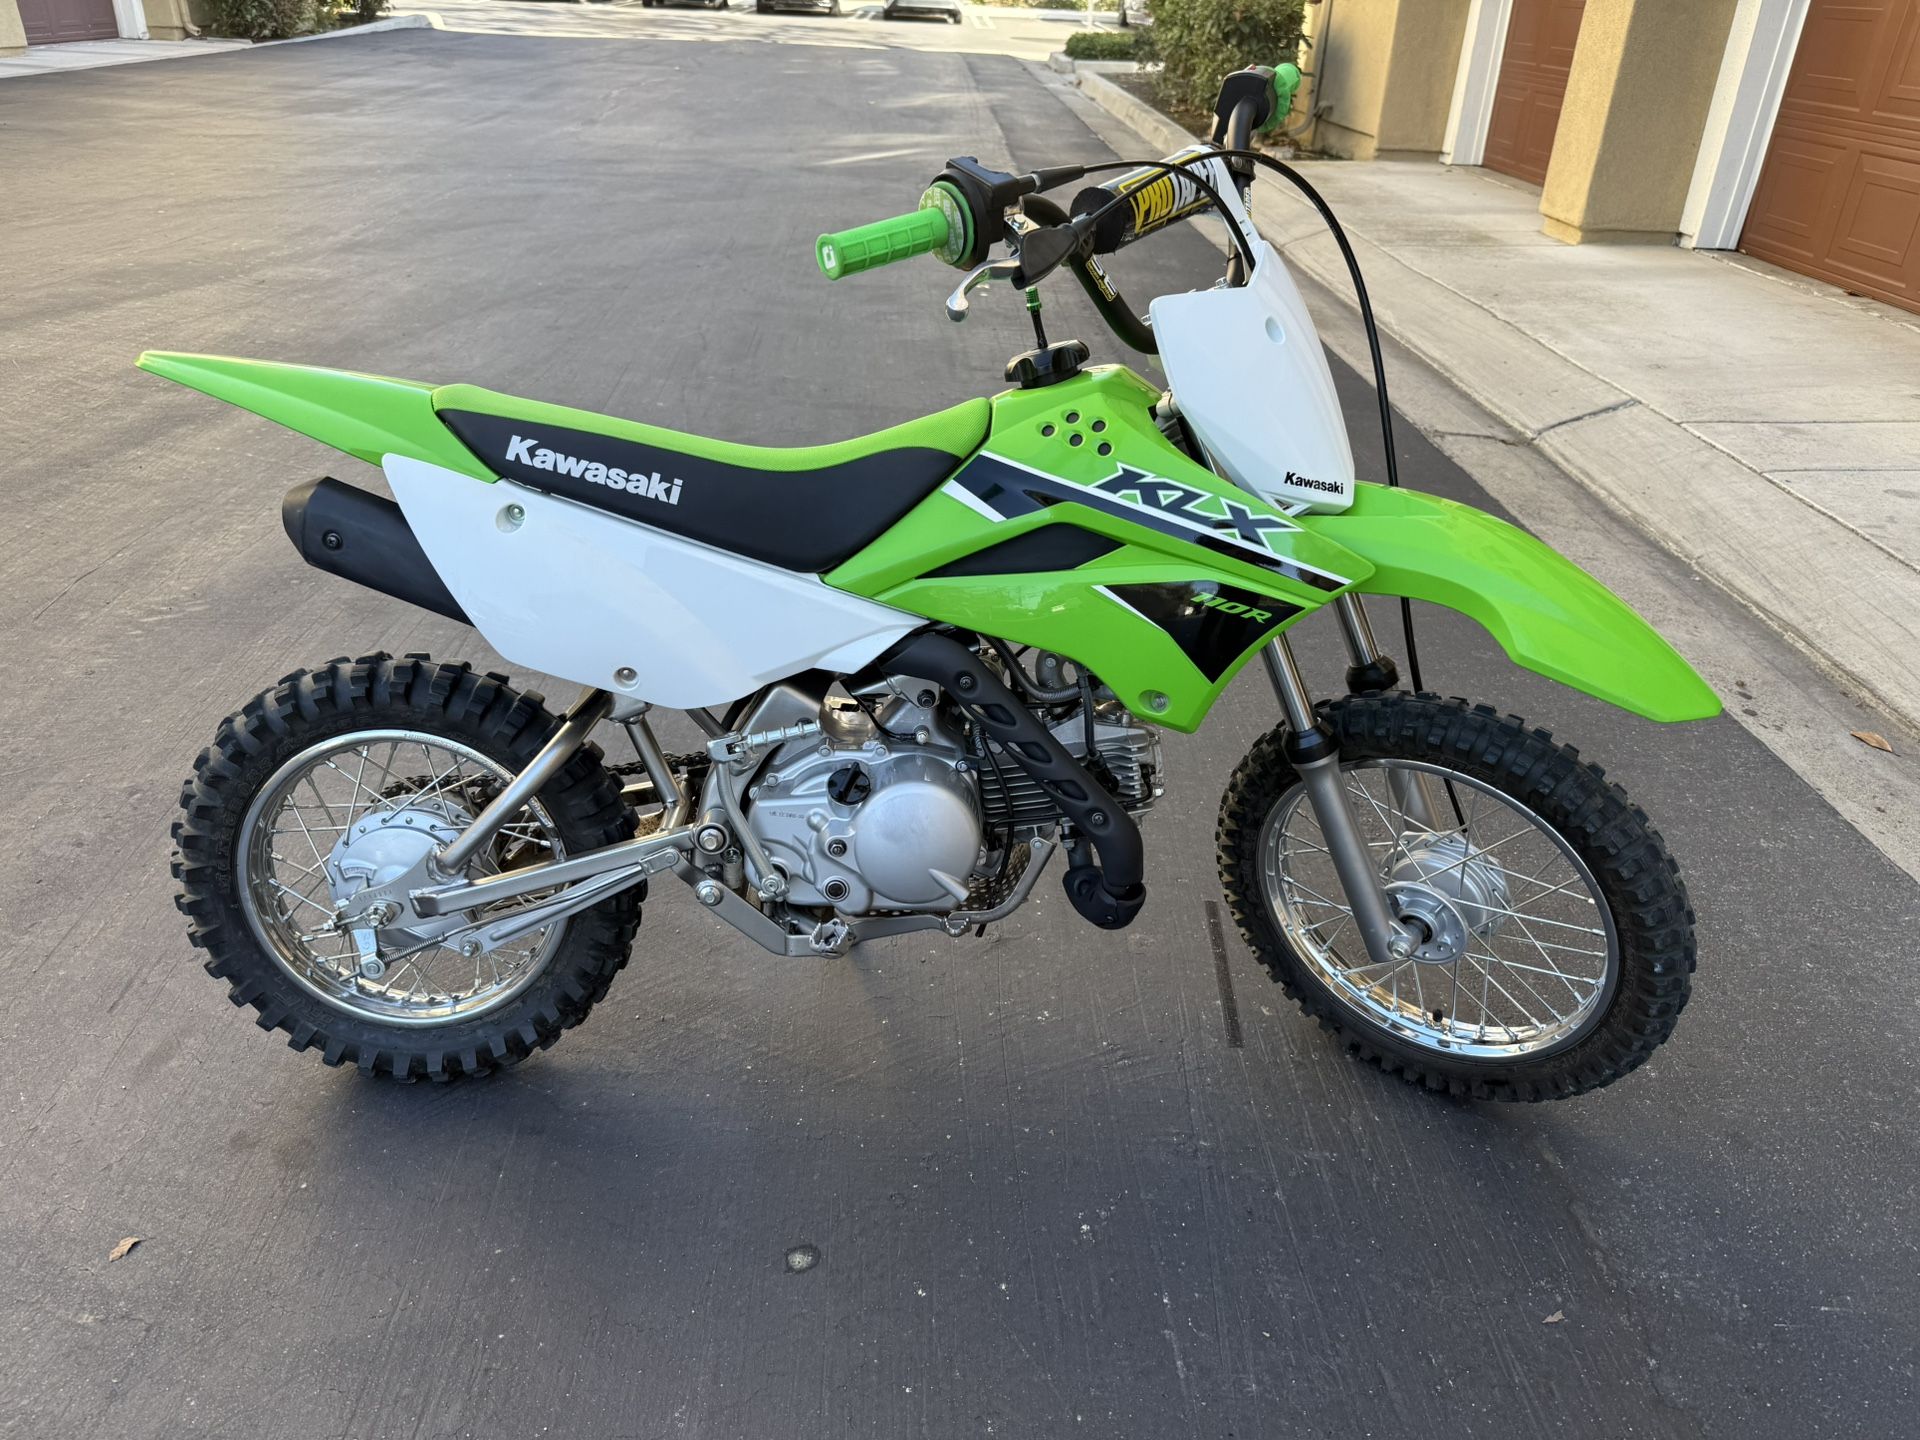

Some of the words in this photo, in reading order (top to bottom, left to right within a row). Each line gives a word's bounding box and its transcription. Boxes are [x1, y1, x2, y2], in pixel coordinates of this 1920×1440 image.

[505, 434, 683, 505] Kawasaki
[1284, 471, 1344, 494] Kawasaki
[1092, 462, 1304, 552] KLX
[1190, 591, 1273, 623] 110R
